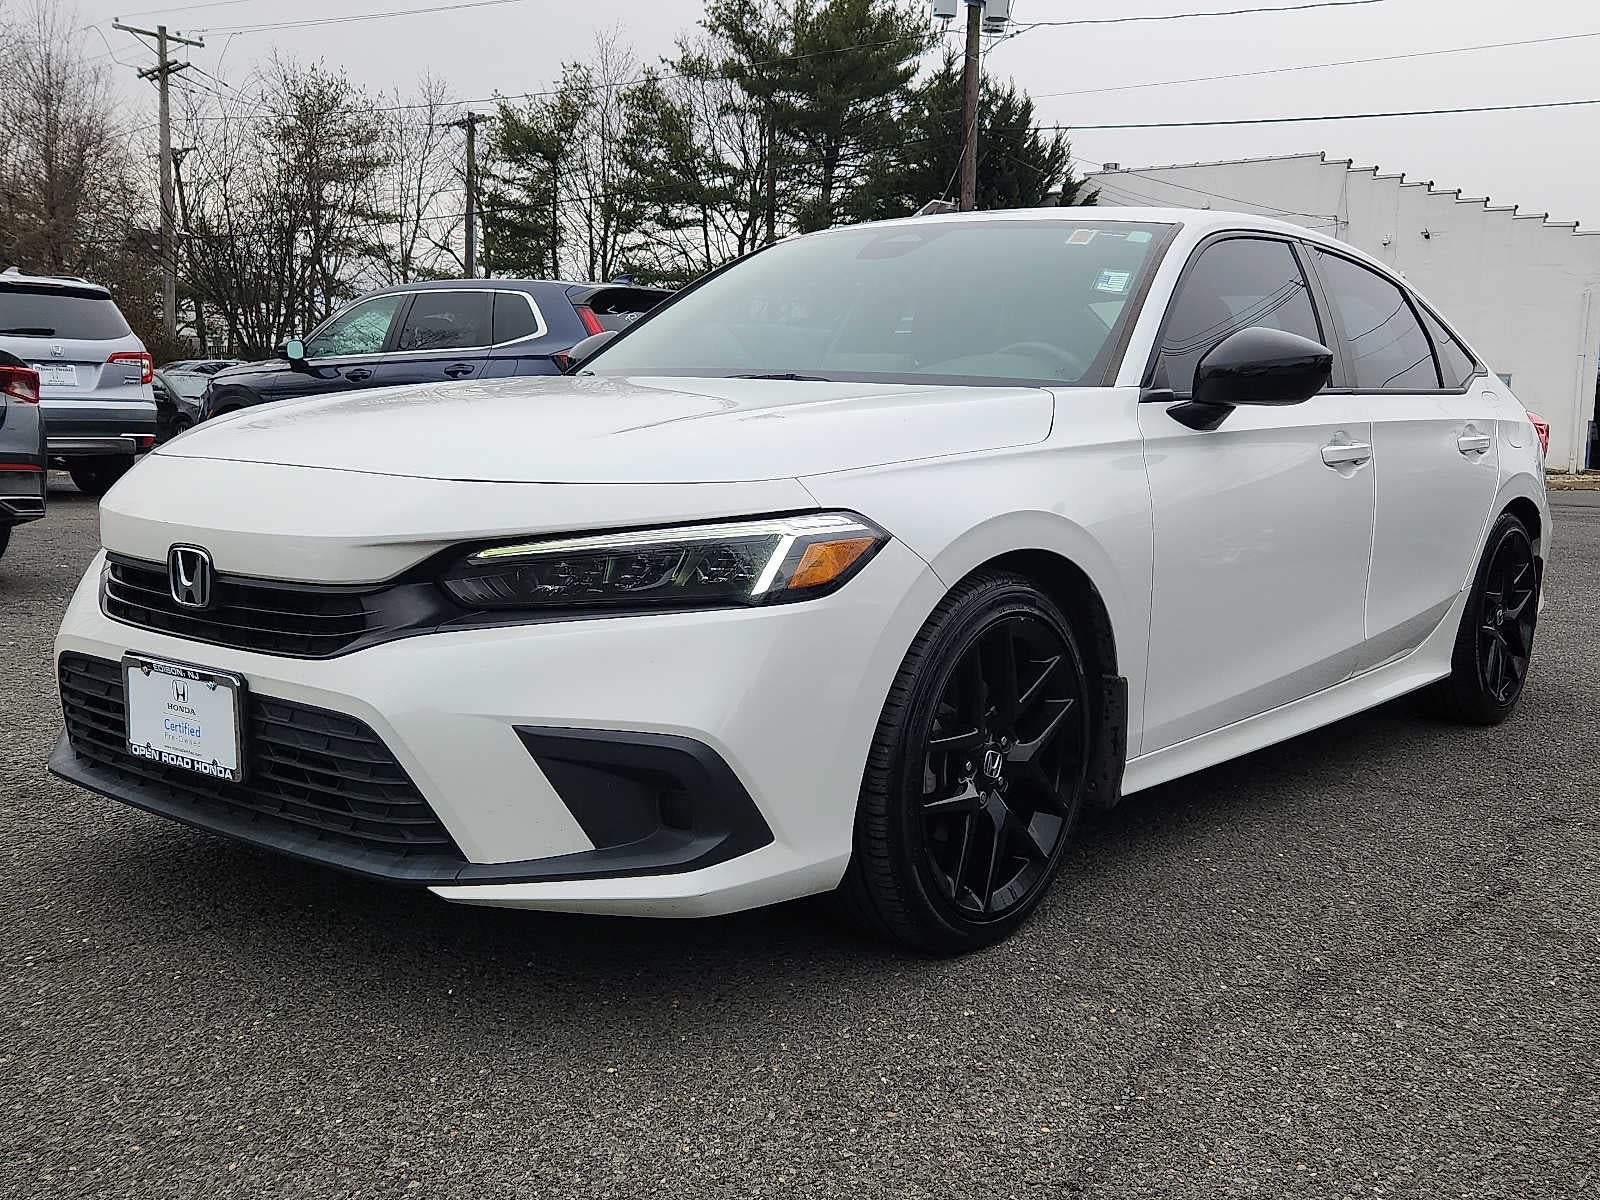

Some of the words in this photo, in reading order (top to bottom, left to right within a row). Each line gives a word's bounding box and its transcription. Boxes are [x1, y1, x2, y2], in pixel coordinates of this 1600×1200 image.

[152, 664, 186, 677] EDISON,
[187, 670, 200, 680] NJ
[167, 703, 196, 716] HONDA
[164, 718, 201, 738] Certified
[132, 745, 160, 760] OPEN
[161, 753, 192, 770] ROAD
[194, 761, 233, 781] HONDA
